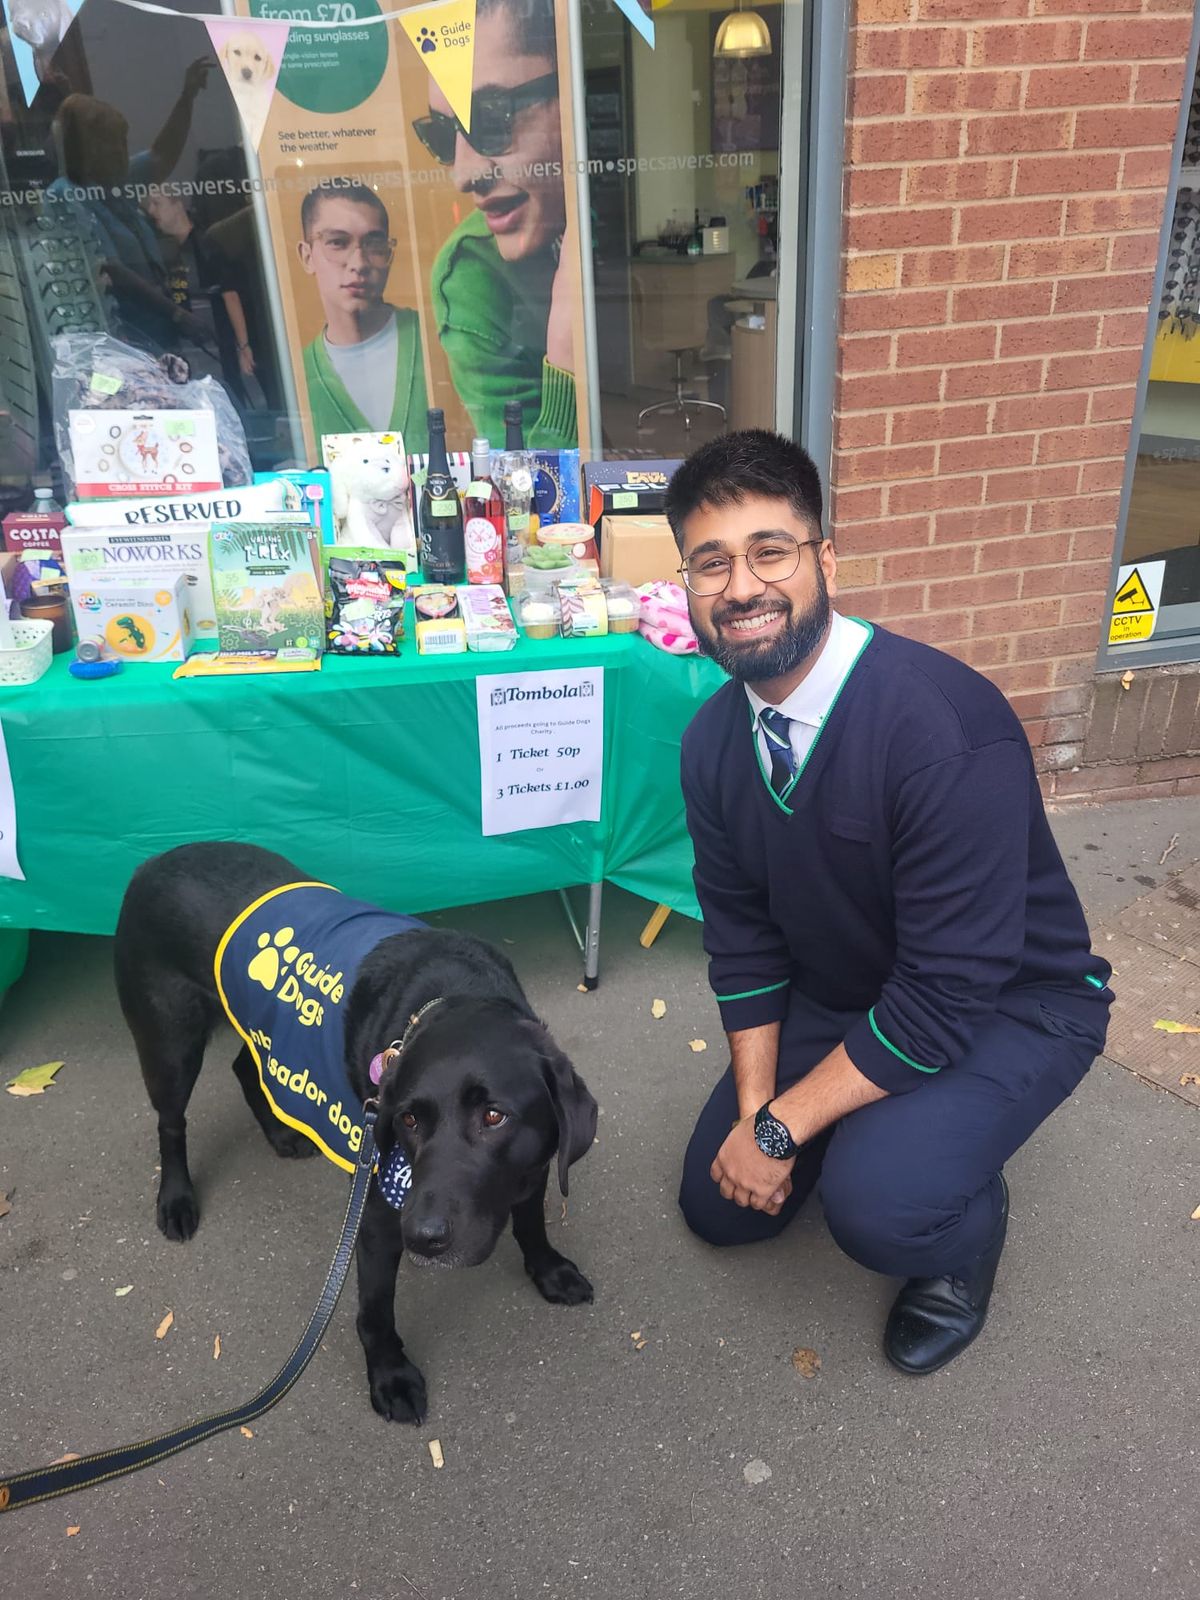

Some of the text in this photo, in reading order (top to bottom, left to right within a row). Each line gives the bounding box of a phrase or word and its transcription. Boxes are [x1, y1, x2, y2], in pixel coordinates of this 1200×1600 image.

[259, 3, 356, 22] from £70
[440, 20, 471, 36] Guide
[314, 30, 370, 44] sunglasses
[443, 35, 470, 48] Dogs
[278, 127, 376, 140] See better, whatever
[280, 141, 338, 153] the weather
[124, 178, 277, 203] specsavers.com
[617, 152, 754, 176] specsavers.com
[175, 483, 192, 491] KIT
[124, 500, 242, 525] RESERVED
[9, 528, 60, 541] COSTA
[1114, 616, 1142, 626] CCTV
[1110, 631, 1142, 641] operation
[506, 685, 578, 701] Tombola
[504, 721, 532, 731] proceeds
[533, 721, 549, 730] going
[557, 719, 576, 727] Guide
[576, 718, 591, 726] Dogs
[496, 746, 581, 763] 1 Ticket 50p
[496, 779, 590, 800] 3 Tickets £1.00
[296, 952, 344, 1004] Guide
[277, 975, 324, 1026] Dogs
[328, 1101, 363, 1152] dog
